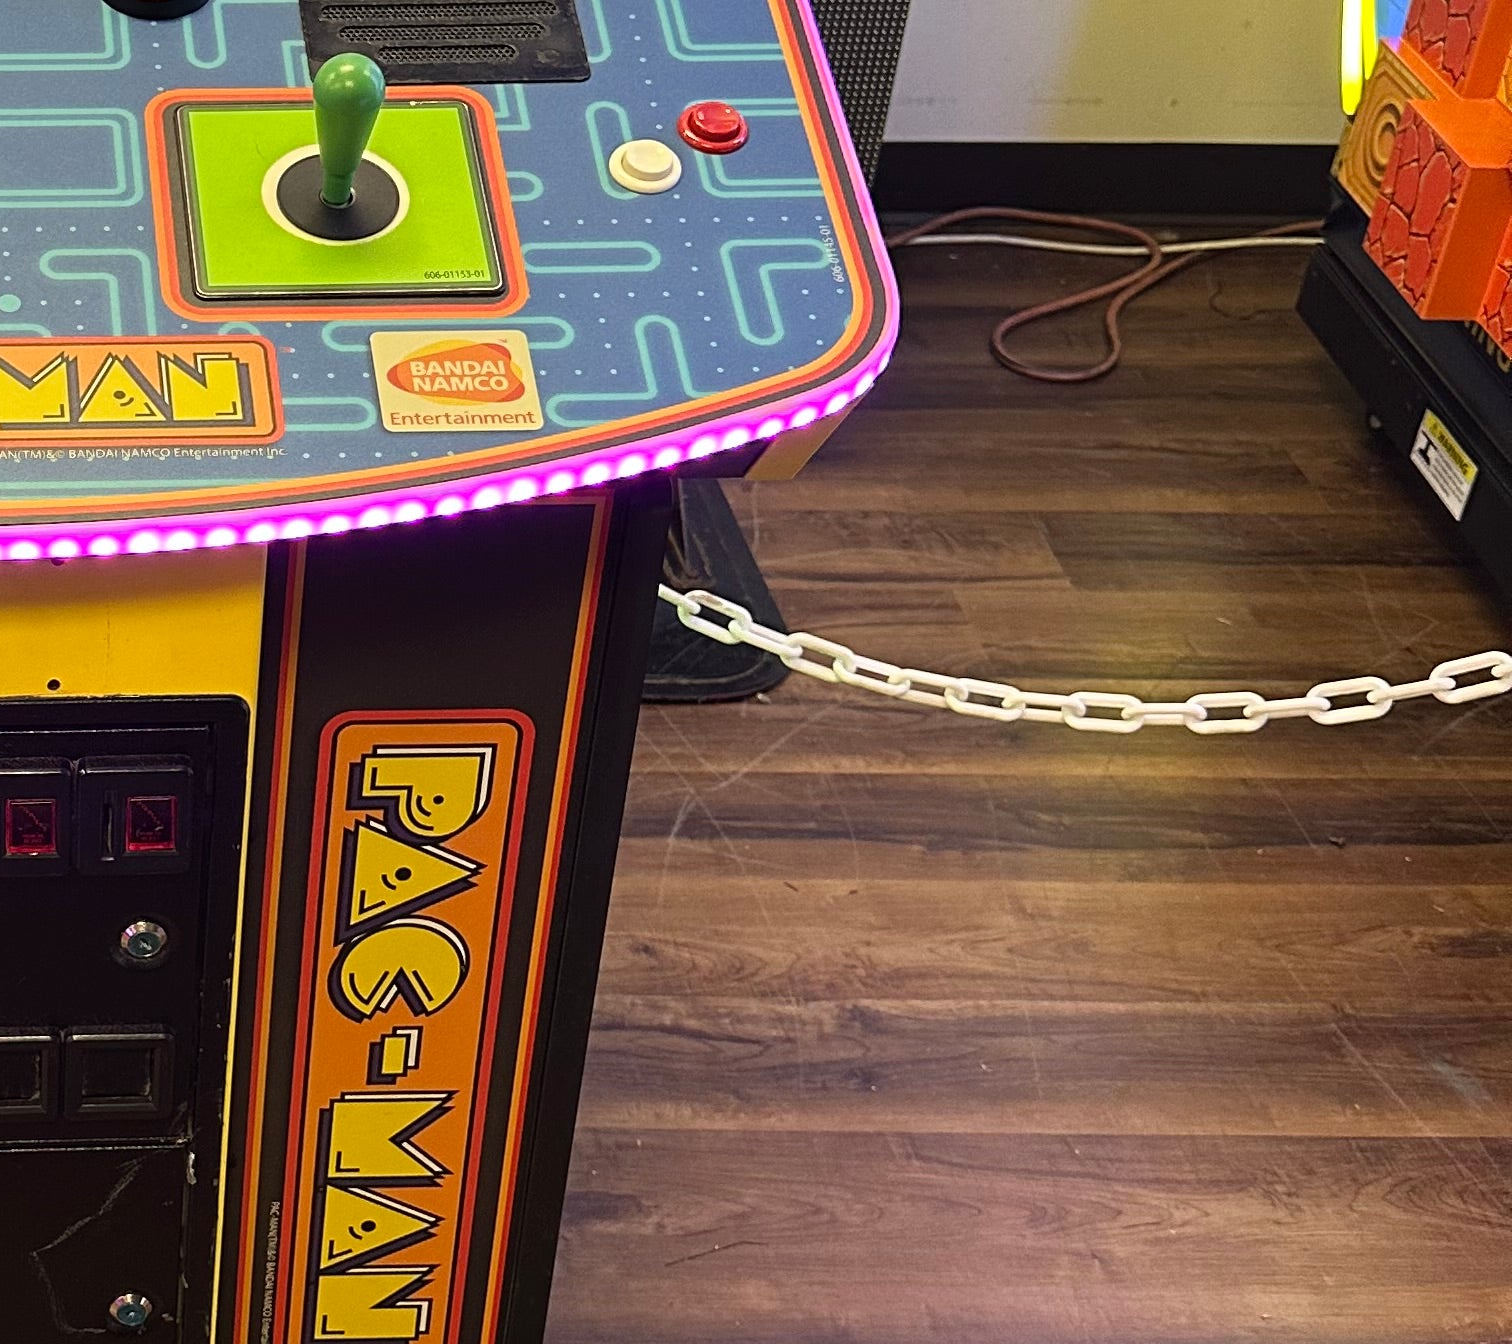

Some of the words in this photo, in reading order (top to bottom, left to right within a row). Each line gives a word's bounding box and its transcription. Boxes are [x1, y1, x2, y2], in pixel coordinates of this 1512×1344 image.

[409, 360, 507, 377] BANDAI
[412, 375, 510, 393] NAMCO
[390, 410, 537, 426] Entertainment
[68, 449, 118, 460] BANDAI
[121, 447, 171, 458] NAMCO
[173, 446, 263, 457] Entertainment
